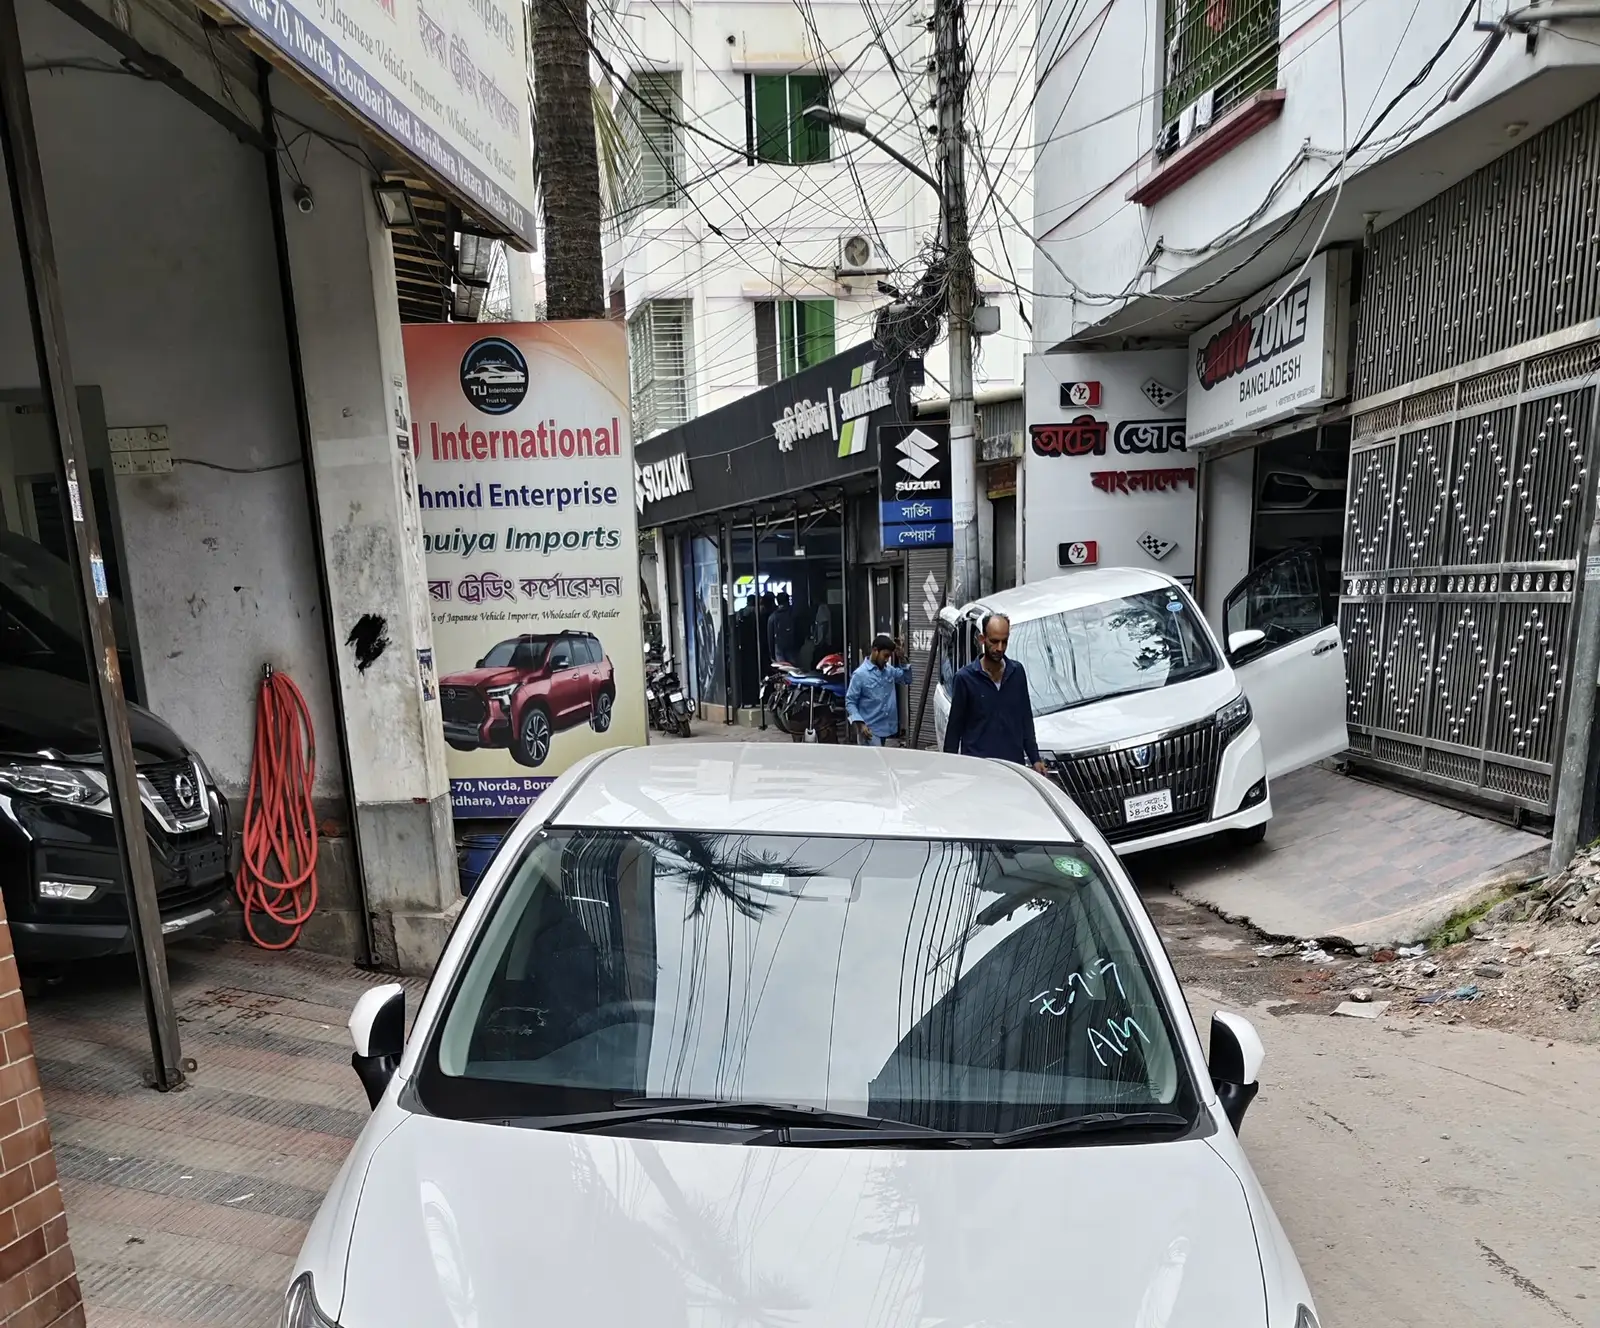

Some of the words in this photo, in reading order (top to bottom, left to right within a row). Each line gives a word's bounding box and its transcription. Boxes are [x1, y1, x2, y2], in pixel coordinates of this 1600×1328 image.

[330, 1, 374, 55] Japanese
[375, 39, 407, 86] Vehicle
[295, 15, 337, 82] Norda,
[338, 54, 385, 119] Borobari
[386, 96, 414, 146] Road,
[414, 120, 458, 181] Baridhara,
[458, 156, 485, 202] Vatara,
[485, 179, 524, 232] Dhaka-1212
[470, 385, 487, 396] TU
[488, 386, 524, 394] International
[1239, 354, 1302, 403] BANGLADESH
[429, 417, 621, 461] International
[1030, 415, 1109, 456] অটো
[642, 452, 692, 504] SUZUKI
[895, 480, 941, 492] SUZUKI
[1090, 467, 1197, 495] বাংলাদেশ
[418, 483, 482, 508] hmid
[489, 480, 618, 512] Enterprise
[901, 502, 933, 519] সার্ভিস
[505, 526, 620, 554] Imports
[898, 525, 937, 543] স্পেয়ার্স
[458, 572, 515, 602] ট্রেডিং
[520, 573, 621, 597] কর্পোরেশন
[437, 612, 446, 624] of
[446, 613, 478, 624] Japanese
[480, 611, 506, 621] Vehicle
[507, 611, 539, 623] Importer,
[541, 609, 580, 620] Wholesaler
[591, 608, 621, 620] Retailer
[912, 629, 936, 652] SUZ
[451, 781, 476, 793] -70,
[478, 780, 521, 792] Norda,
[451, 795, 496, 807] idhara,
